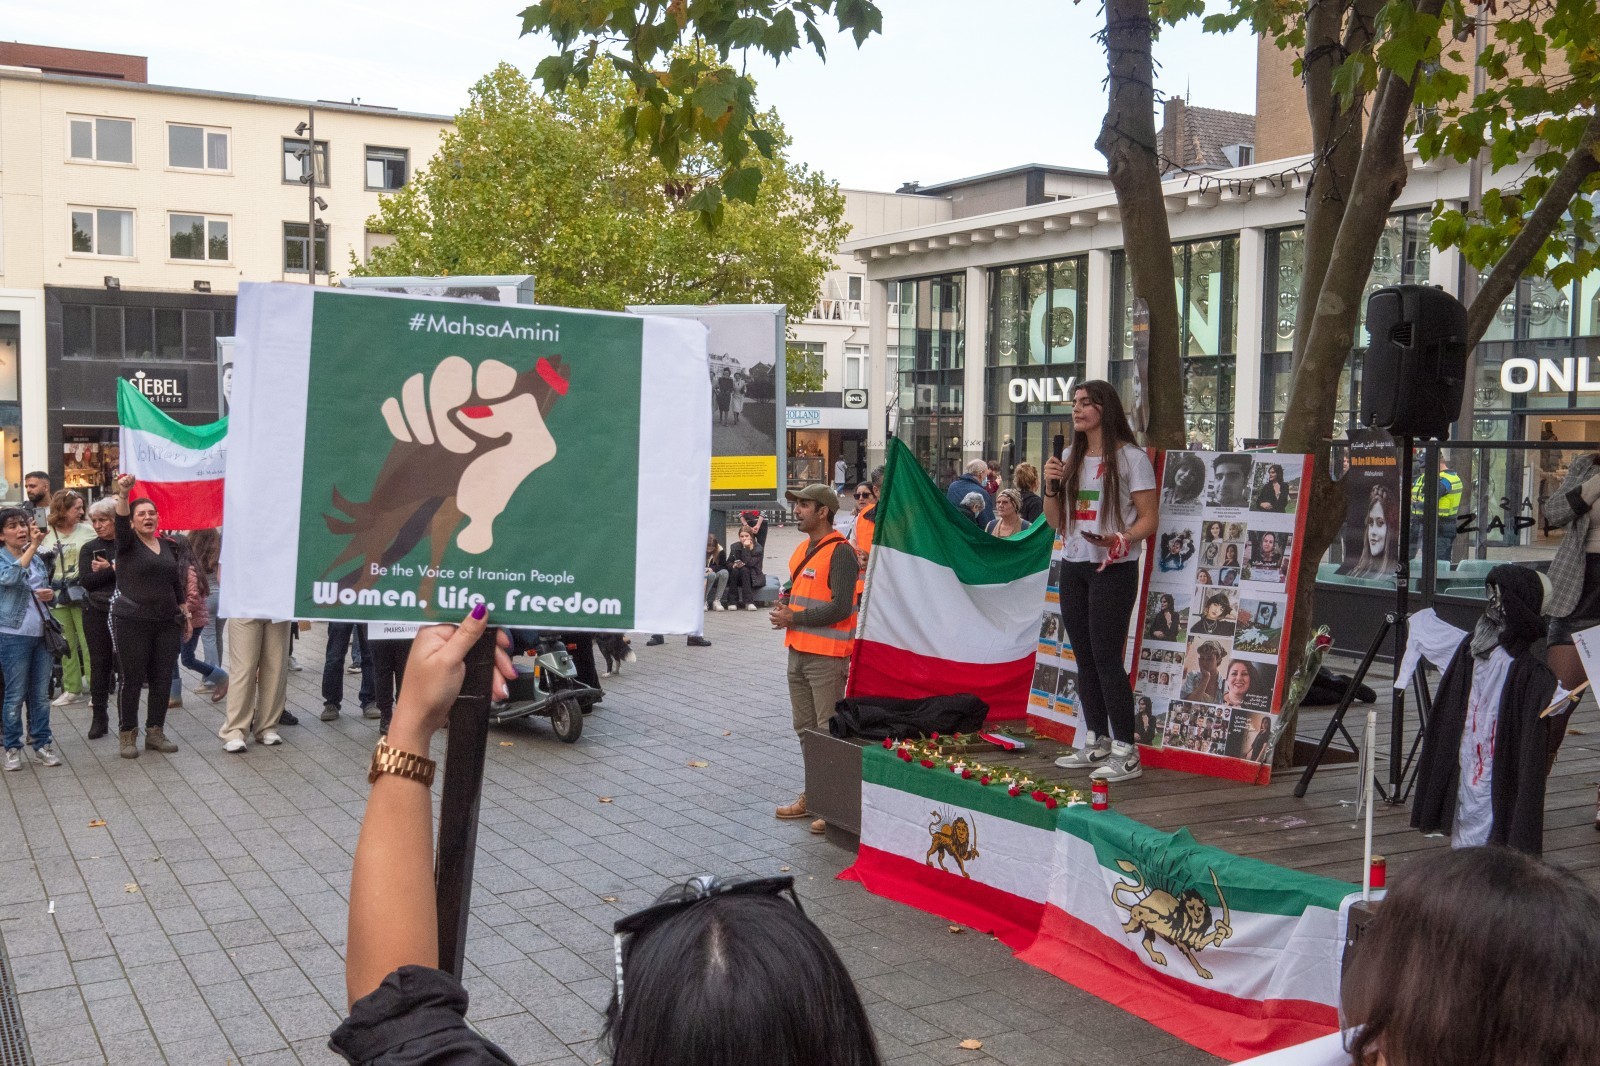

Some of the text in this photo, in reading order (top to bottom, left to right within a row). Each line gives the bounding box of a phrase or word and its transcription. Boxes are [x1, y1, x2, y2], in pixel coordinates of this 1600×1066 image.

[408, 312, 560, 342] #MahsaAmini
[1500, 356, 1600, 393] ONL
[129, 378, 182, 395] SIEBEL
[1008, 376, 1077, 404] ONLY
[149, 395, 183, 403] eliers
[1371, 456, 1385, 466] Mahsa
[370, 563, 575, 586] Be the Voice of Iranian People
[313, 581, 622, 615] Women. Life. Freedom
[383, 626, 418, 634] #MAHSAAMIN
